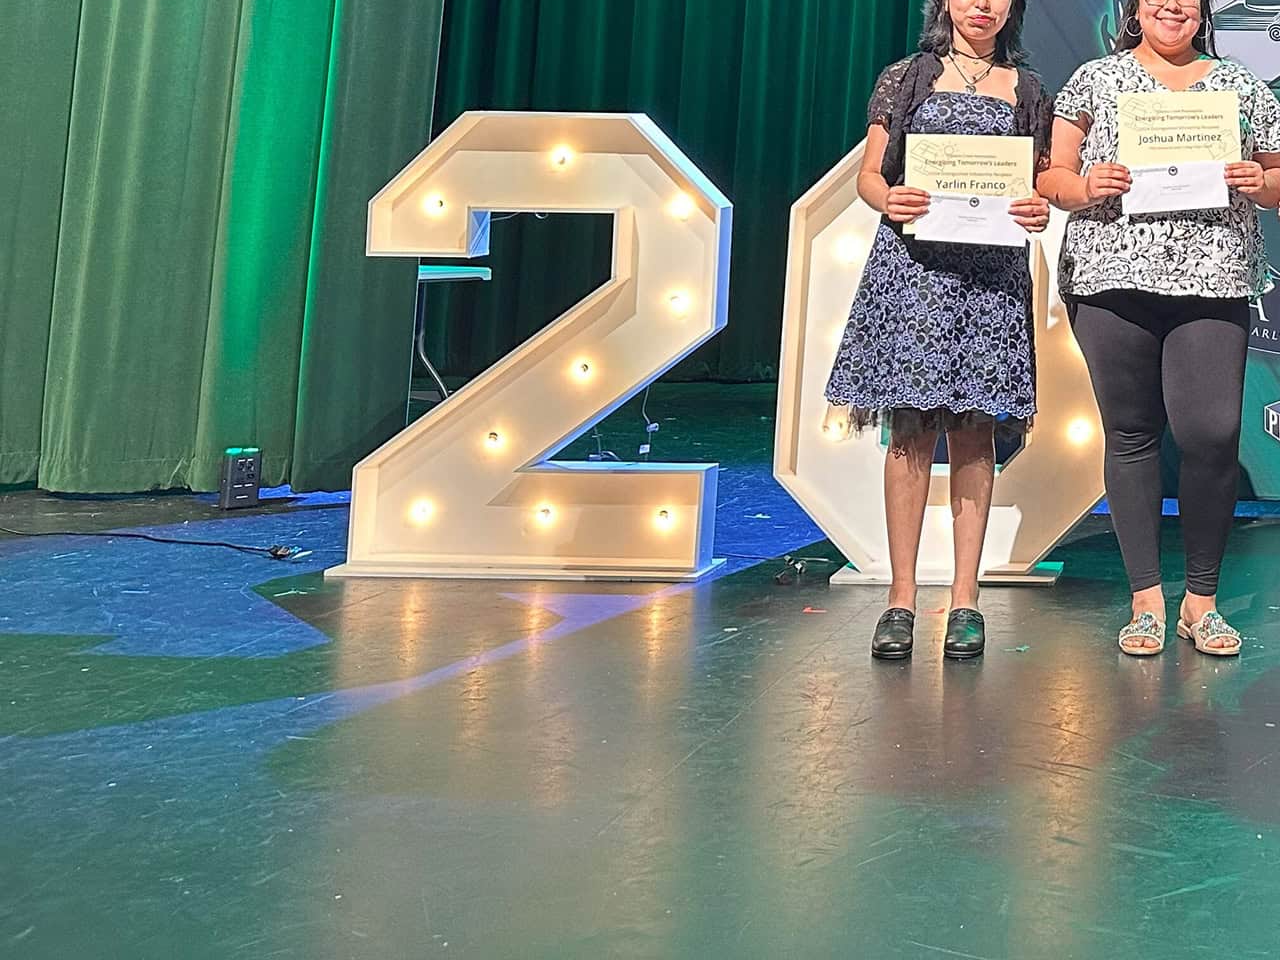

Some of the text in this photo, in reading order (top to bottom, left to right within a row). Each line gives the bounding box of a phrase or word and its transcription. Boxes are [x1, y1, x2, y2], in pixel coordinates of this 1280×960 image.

[1138, 133, 1222, 145] Joshua Martinez
[936, 179, 1006, 190] Yarlin Franco
